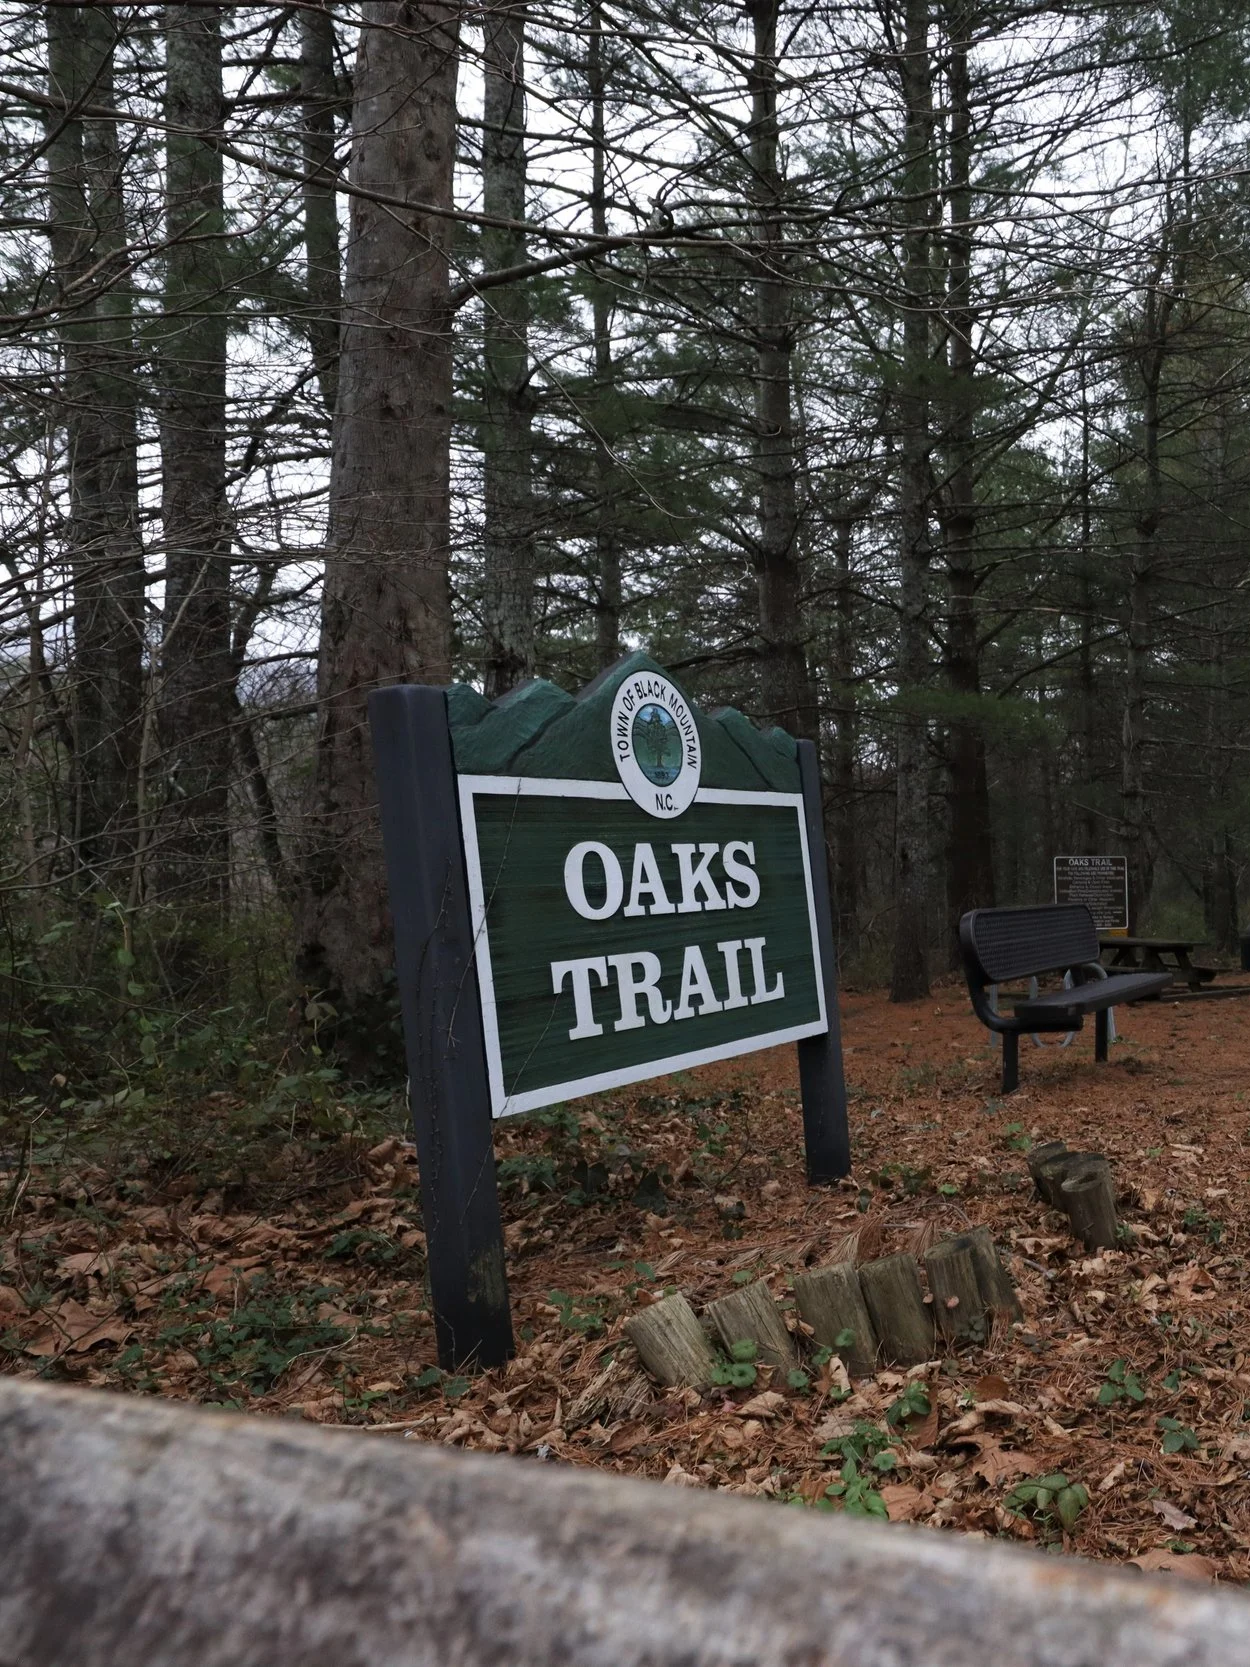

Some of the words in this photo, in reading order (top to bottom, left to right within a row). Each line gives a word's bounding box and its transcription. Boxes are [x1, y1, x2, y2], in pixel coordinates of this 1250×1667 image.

[622, 689, 636, 712] OF
[634, 680, 667, 703] BLACK
[617, 711, 630, 762] TOWN
[668, 693, 698, 770] MOUNTAIN
[564, 840, 761, 921] OAKS
[550, 937, 786, 1041] TRAIL
